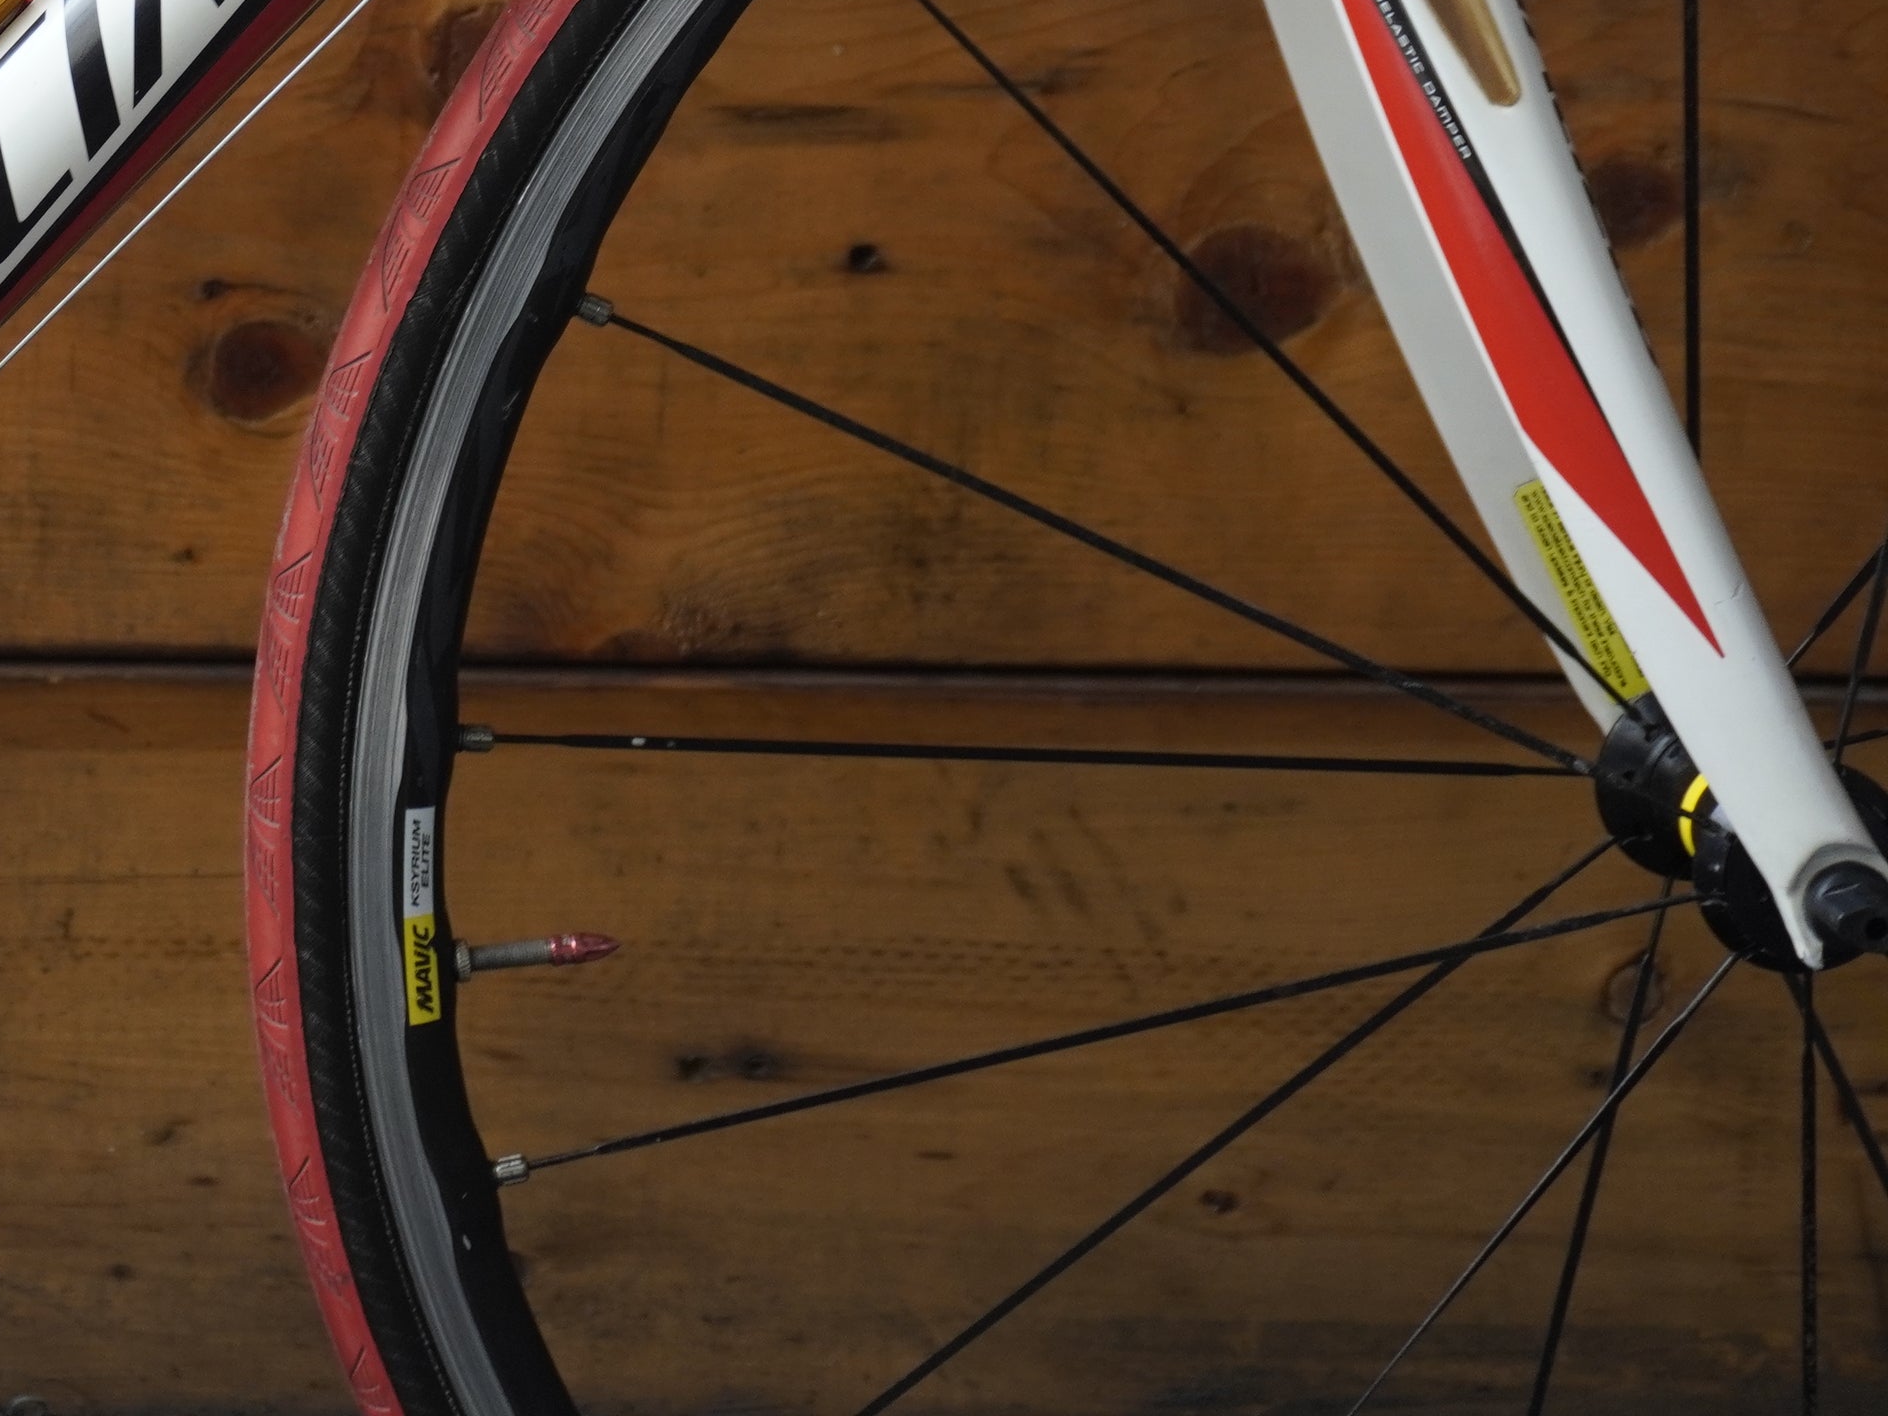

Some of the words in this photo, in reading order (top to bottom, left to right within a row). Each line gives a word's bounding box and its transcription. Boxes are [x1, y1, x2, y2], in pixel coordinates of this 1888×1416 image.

[411, 819, 422, 907] KSYRIUM
[421, 833, 430, 888] ELITE
[413, 924, 434, 1014] MAVIC
